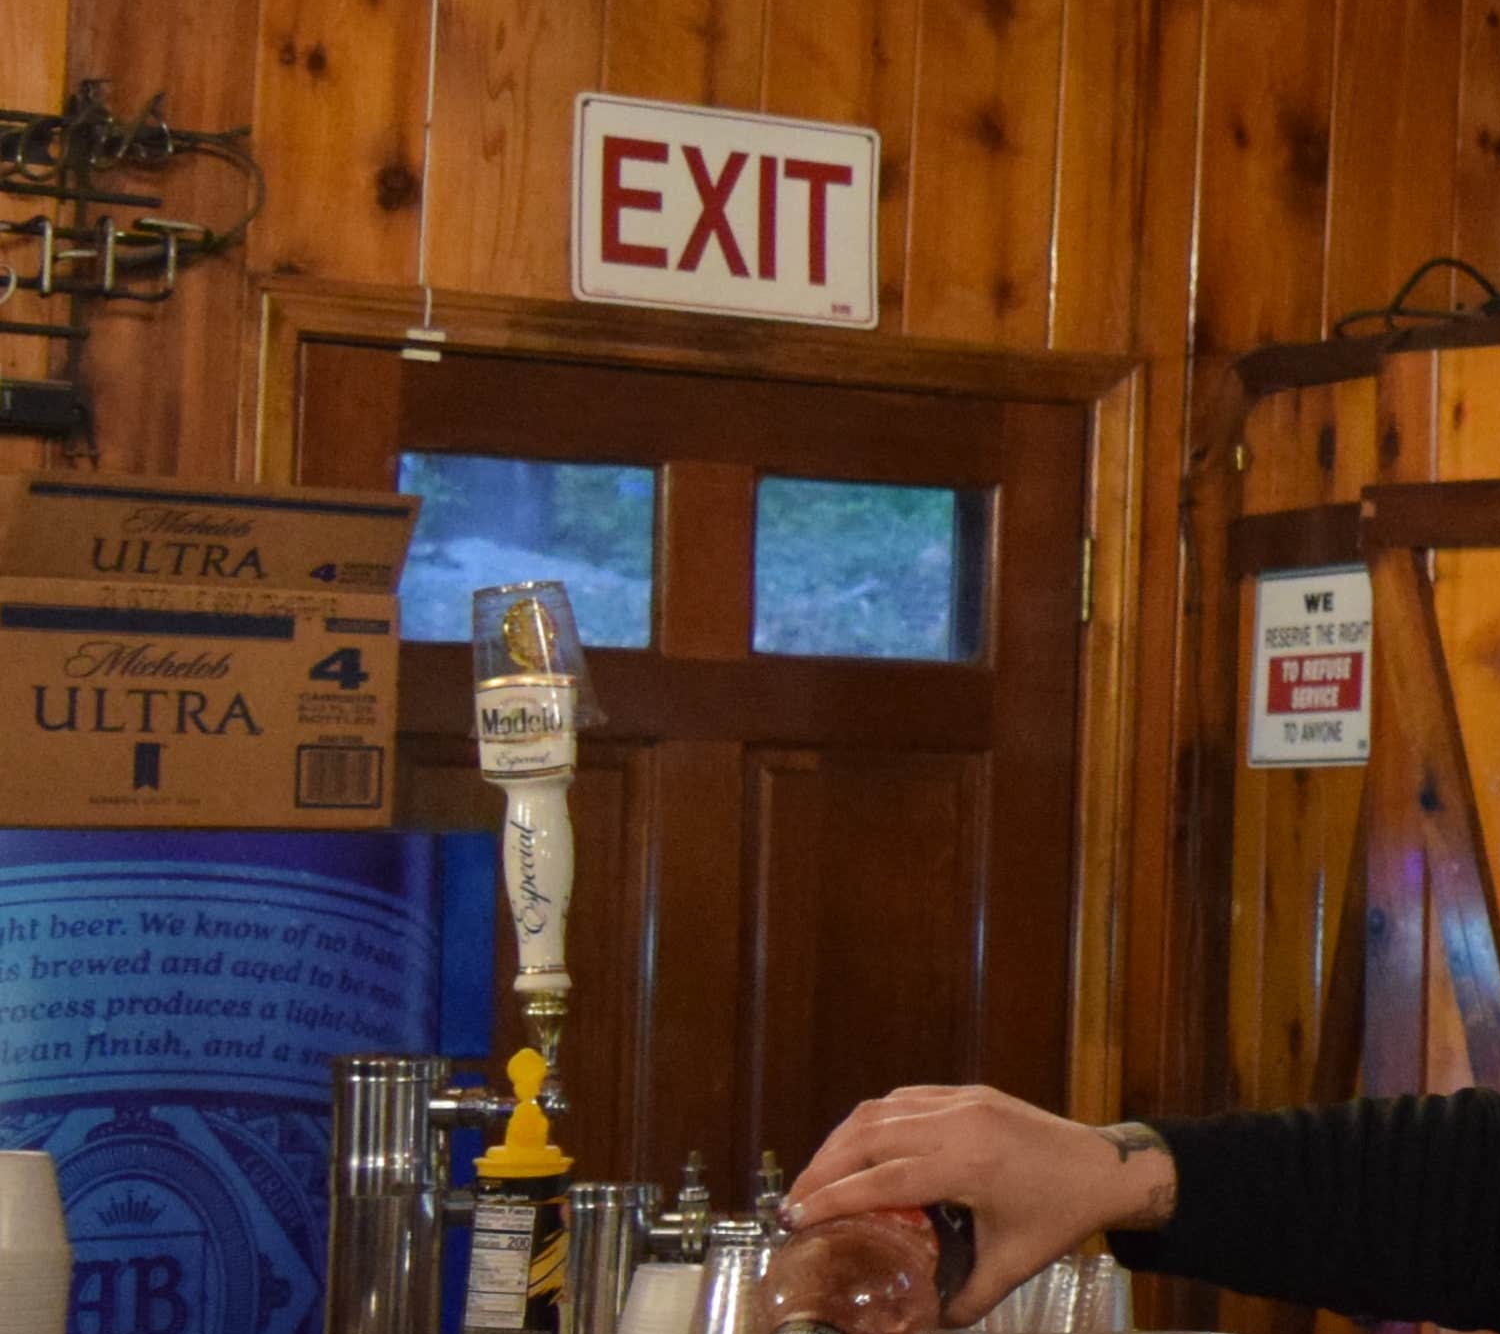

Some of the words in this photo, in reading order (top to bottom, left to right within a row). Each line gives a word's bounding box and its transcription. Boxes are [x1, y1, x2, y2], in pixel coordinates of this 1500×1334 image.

[600, 135, 854, 287] EXIT
[91, 537, 269, 581] ULTRA
[1303, 591, 1335, 614] WE
[1265, 626, 1312, 649] RESERVE
[1316, 624, 1335, 646] THE
[1338, 620, 1371, 645] RIGHT
[64, 640, 235, 681] Michelob
[309, 647, 370, 690] 4
[1282, 660, 1299, 683] TO
[1301, 657, 1353, 682] REFUSE
[33, 685, 265, 737] ULTRA
[1291, 684, 1340, 710] SERVICE
[481, 706, 564, 738] Modelo
[1283, 722, 1298, 744] TO
[1301, 720, 1344, 743] ANYONE
[509, 819, 552, 938] Especial
[50, 914, 127, 940] beer.
[140, 912, 187, 938] We
[195, 913, 278, 941] know
[281, 923, 317, 947] of
[316, 933, 346, 954] no
[30, 949, 152, 981] brewed
[160, 950, 225, 977] and
[231, 960, 301, 986] aged
[308, 966, 334, 990] to
[337, 969, 366, 995] be
[106, 990, 254, 1026] produces
[259, 1001, 277, 1021] a
[82, 1029, 193, 1067] finish,
[202, 1035, 266, 1062] and
[271, 1042, 294, 1063] a
[506, 1236, 531, 1251] 200
